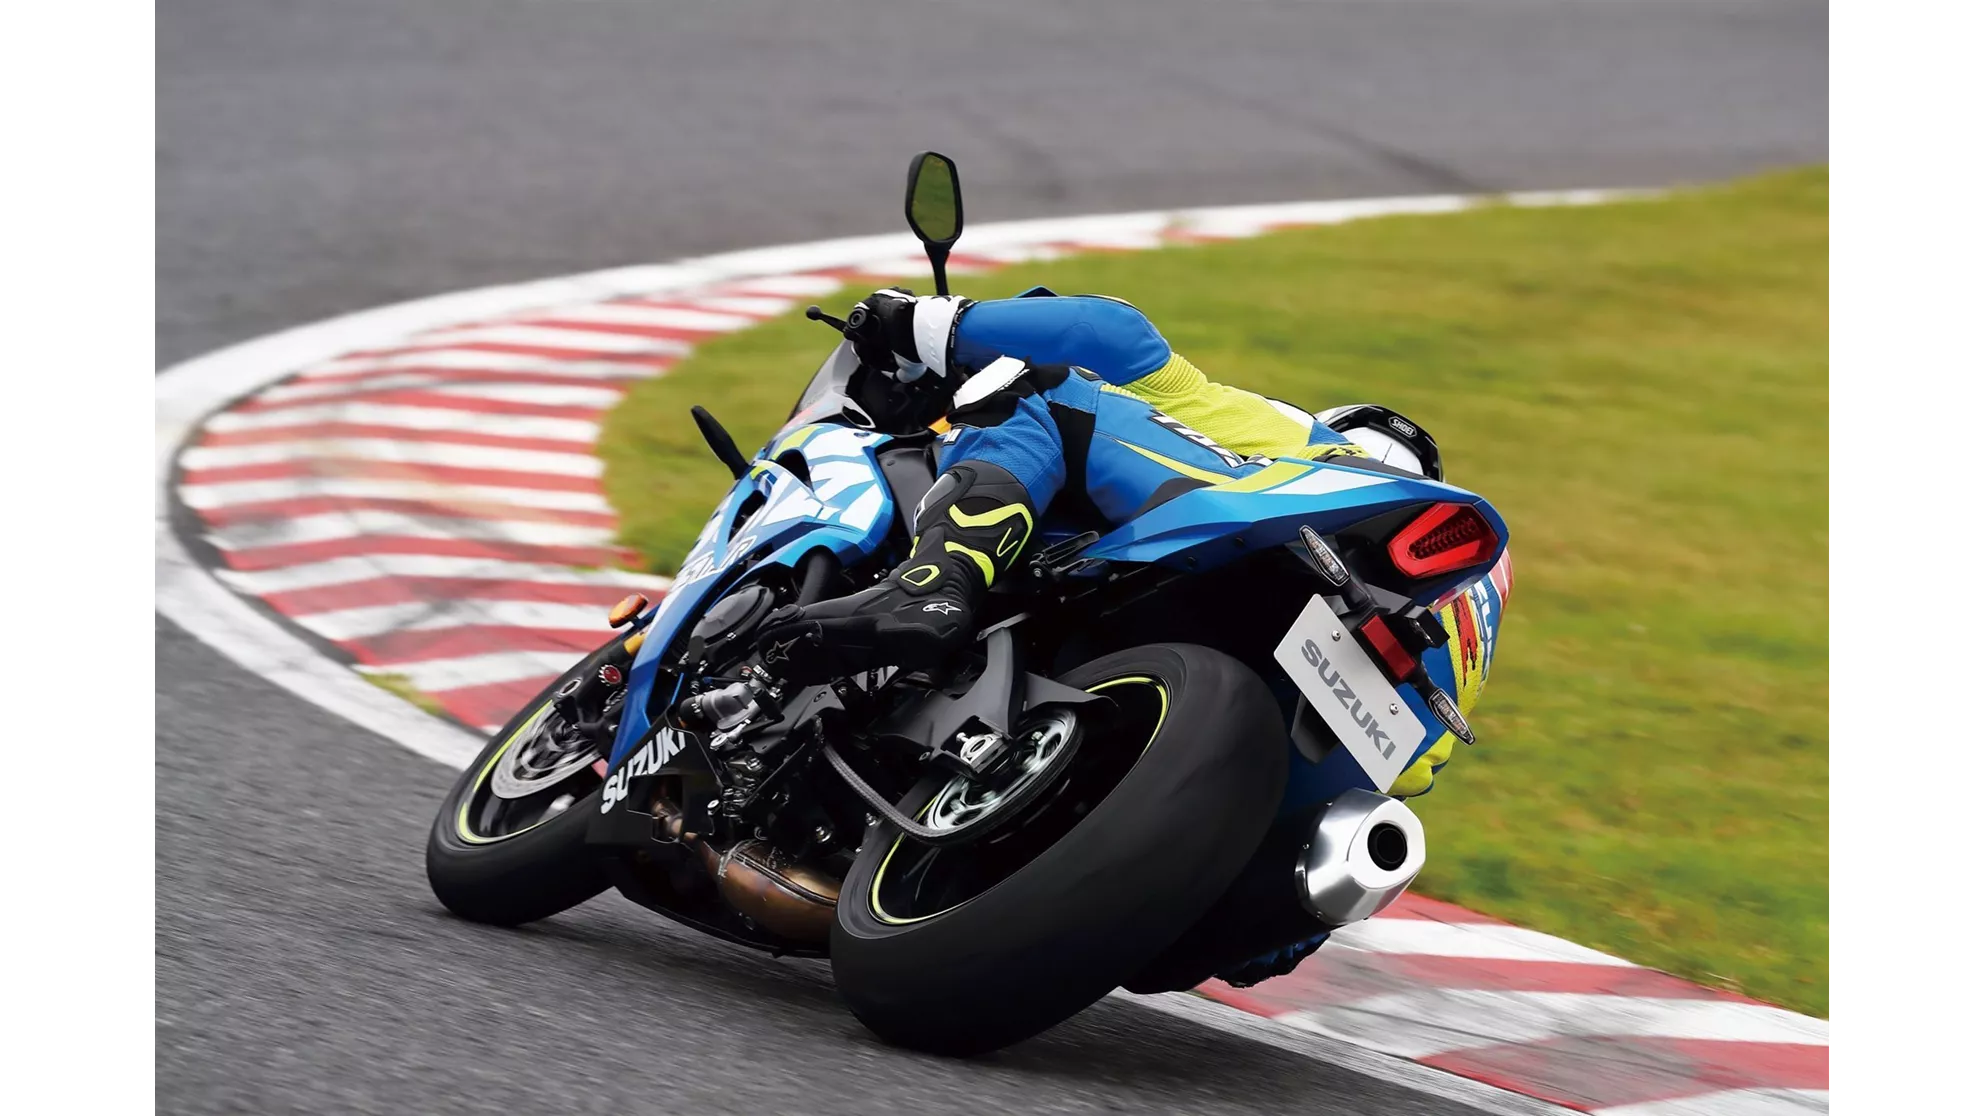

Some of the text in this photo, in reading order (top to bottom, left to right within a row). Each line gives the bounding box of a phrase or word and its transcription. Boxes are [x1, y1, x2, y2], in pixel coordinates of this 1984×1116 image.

[1391, 418, 1414, 436] SHOEI
[1301, 638, 1397, 760] SUZUKI
[600, 726, 686, 815] SUZUKI
